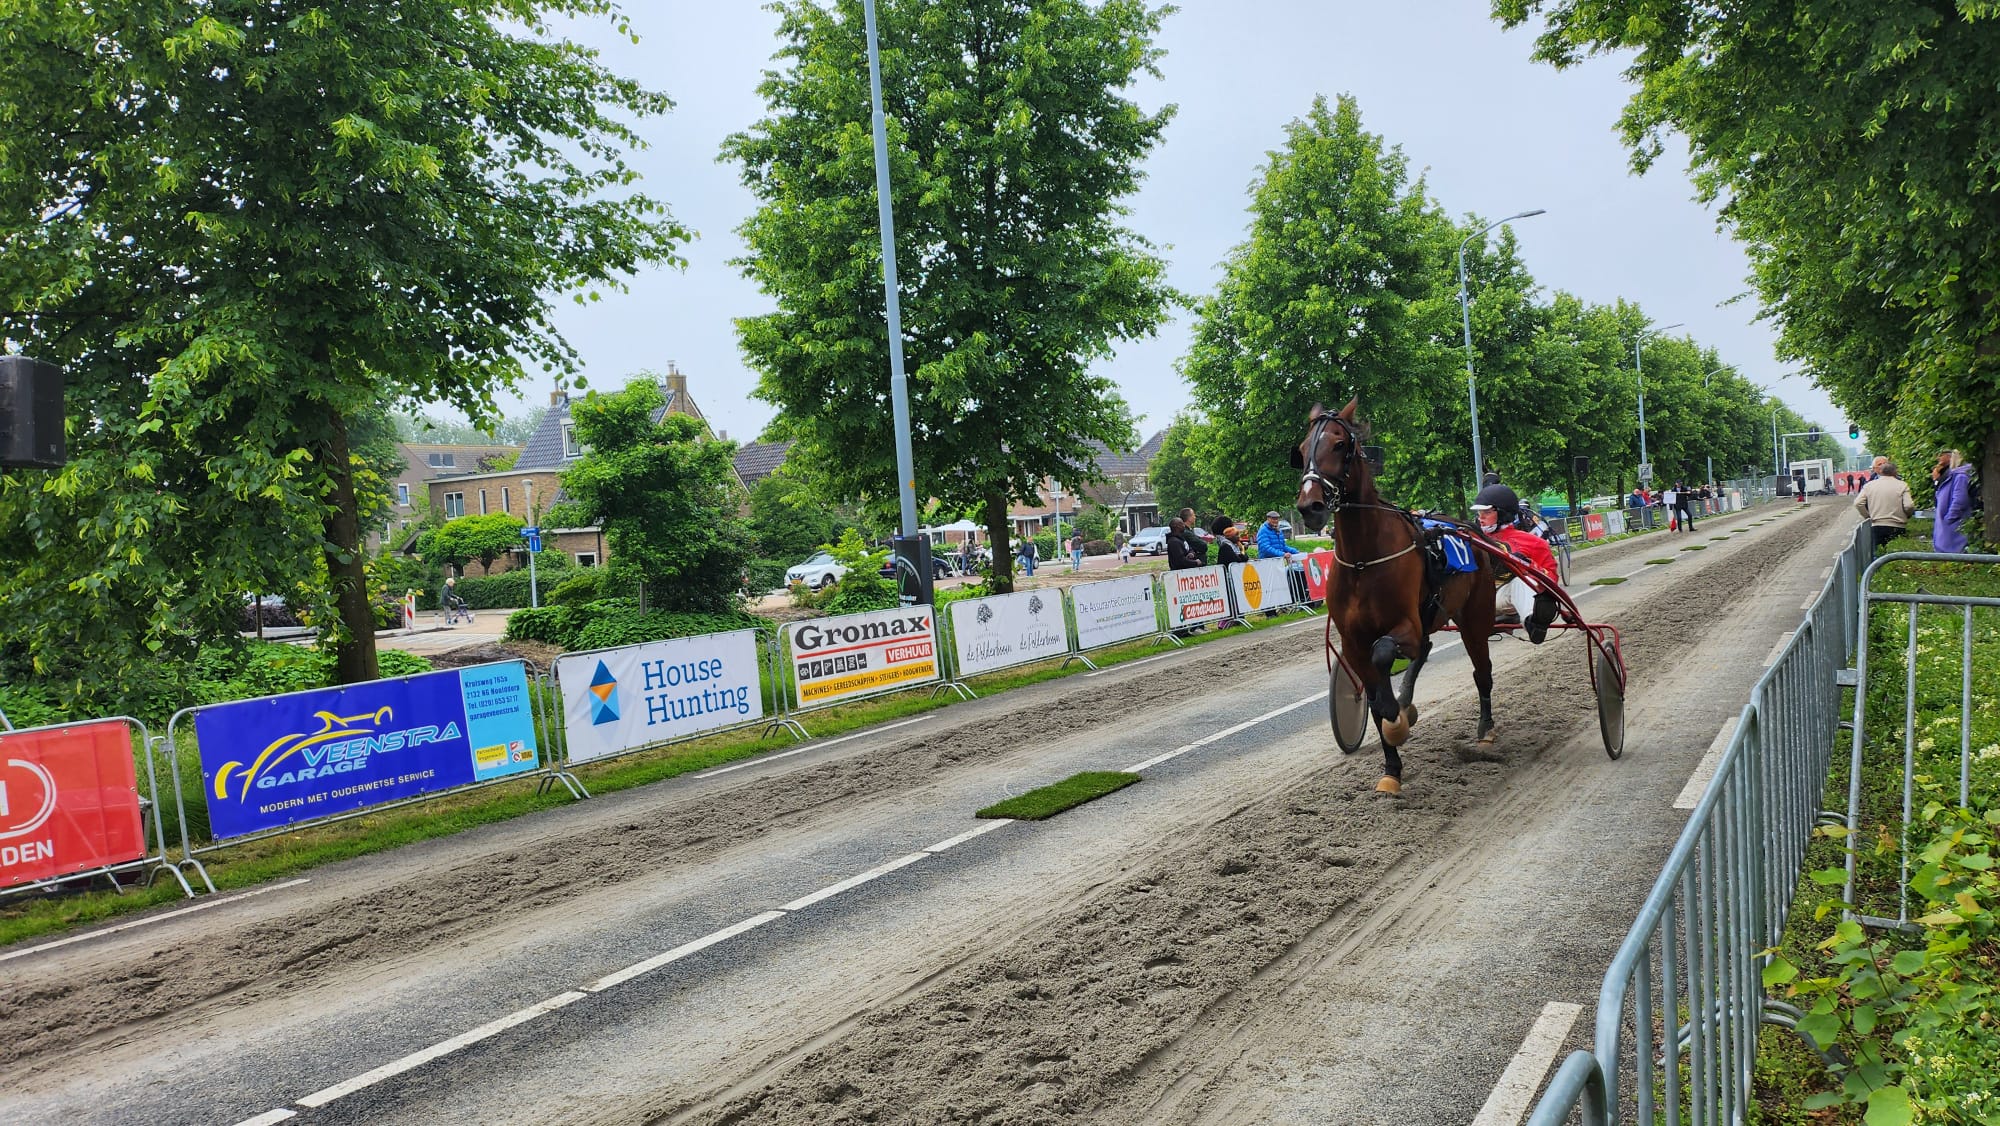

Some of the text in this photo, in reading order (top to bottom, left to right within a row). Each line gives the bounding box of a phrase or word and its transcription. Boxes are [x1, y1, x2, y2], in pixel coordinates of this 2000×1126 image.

[795, 616, 926, 650] Gromax
[887, 643, 931, 661] VERHUUR
[641, 658, 722, 691] House
[803, 686, 830, 697] MACHINES
[879, 671, 900, 681] STEIGERS
[644, 683, 750, 726] Hunting
[301, 721, 462, 767] VEENSTRA
[256, 757, 368, 788] GARAGE
[259, 769, 436, 814] MODERN MET OUDERWETSE SERVICE
[0, 839, 54, 867] DEN
